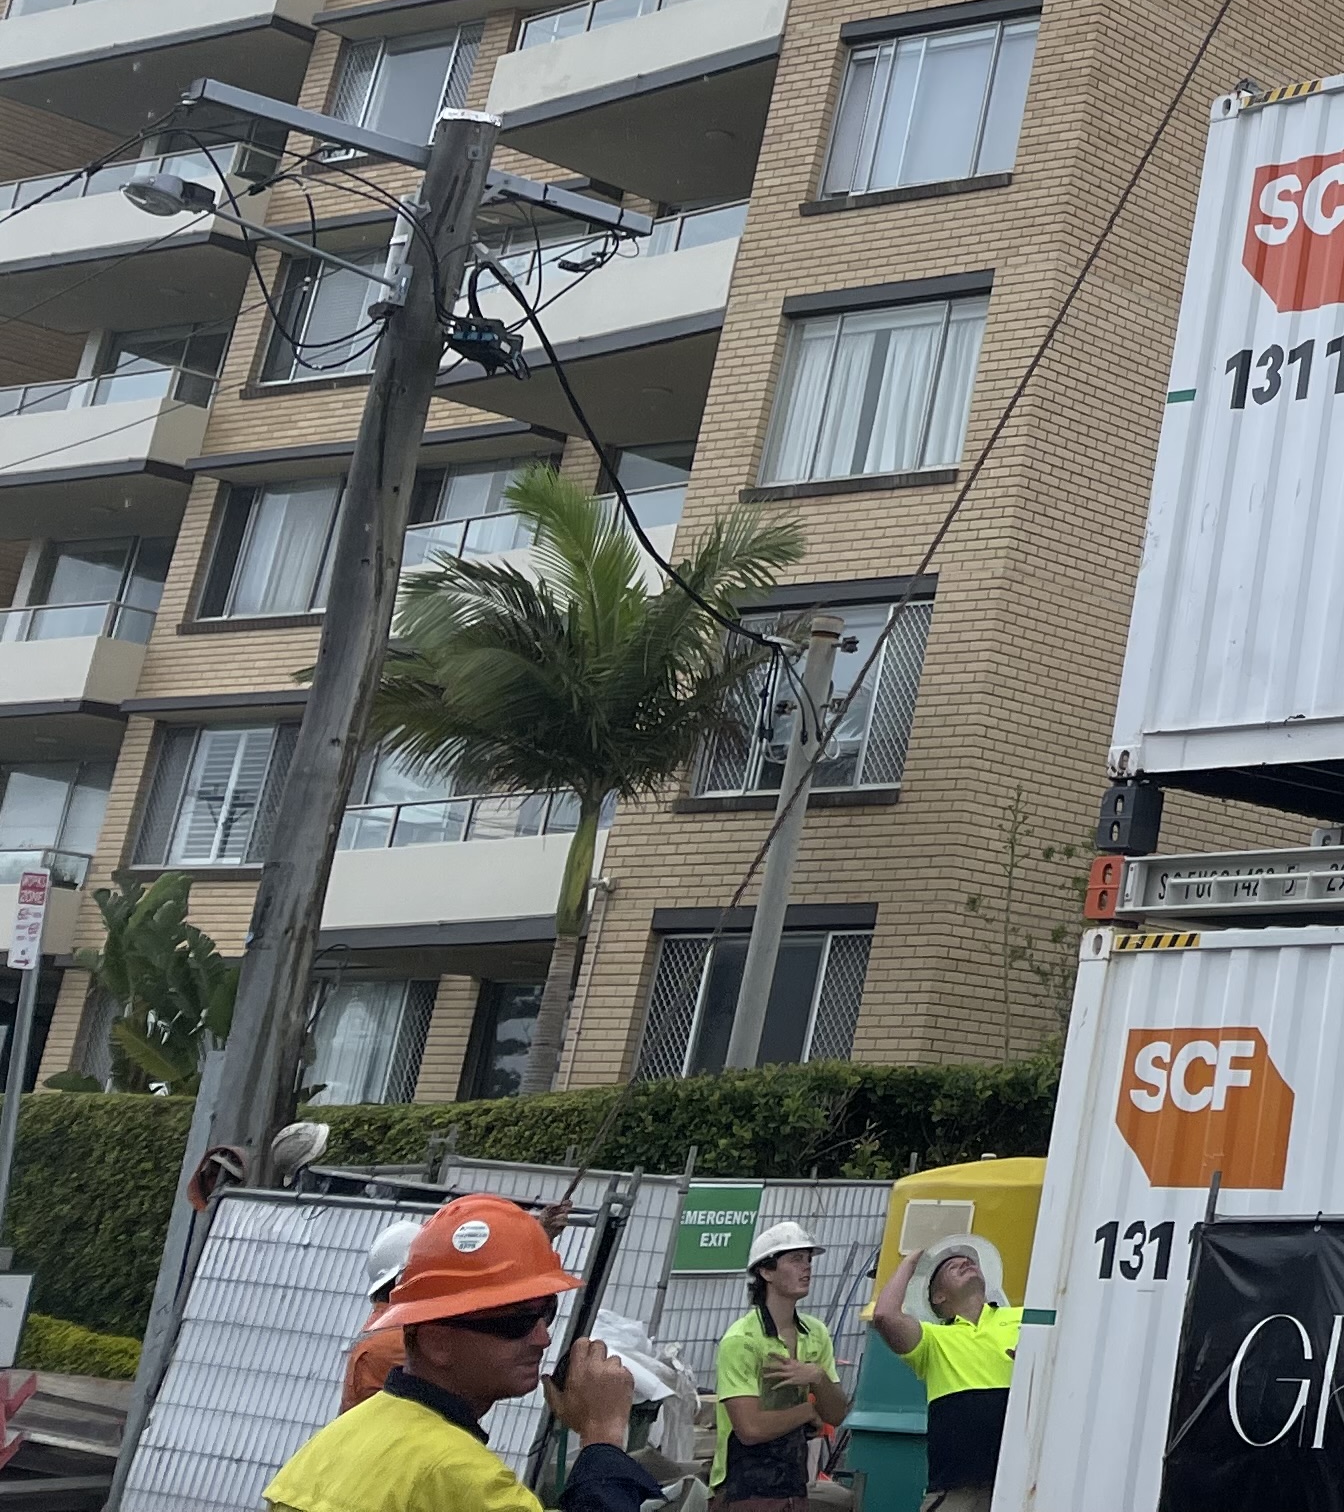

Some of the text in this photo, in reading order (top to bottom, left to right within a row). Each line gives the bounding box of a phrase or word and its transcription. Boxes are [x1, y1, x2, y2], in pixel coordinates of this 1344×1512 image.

[1224, 339, 1316, 410] 131
[1129, 1040, 1256, 1113] SCF
[699, 1232, 732, 1248] EXIT
[1094, 1220, 1176, 1281] 131
